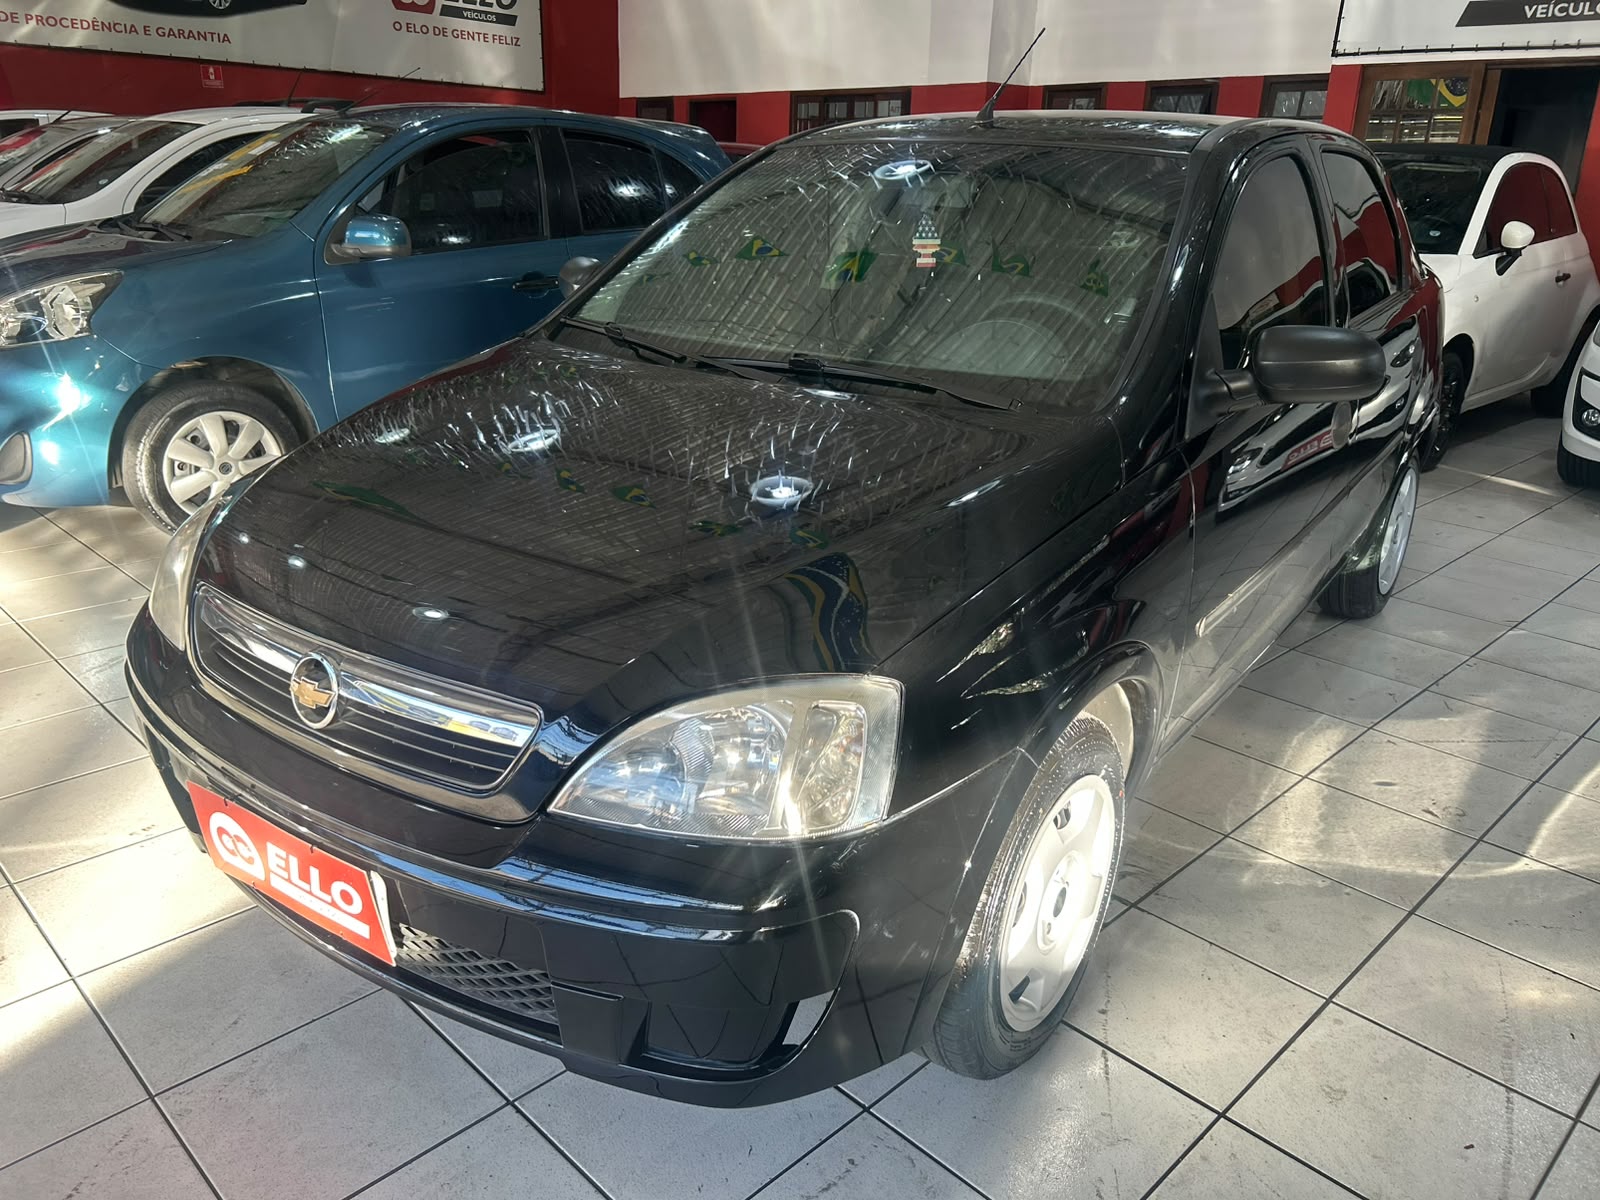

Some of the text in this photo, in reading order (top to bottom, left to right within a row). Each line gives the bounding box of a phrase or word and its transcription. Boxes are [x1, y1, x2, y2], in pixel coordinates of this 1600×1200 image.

[25, 13, 139, 35] PROCEDÊNCIA
[143, 25, 152, 36] E
[156, 27, 231, 44] GARANTIA
[463, 10, 497, 21] VEÍCULOS
[393, 21, 521, 47] O ELO DE GENTE FELIZ
[266, 841, 363, 915] ELLO
